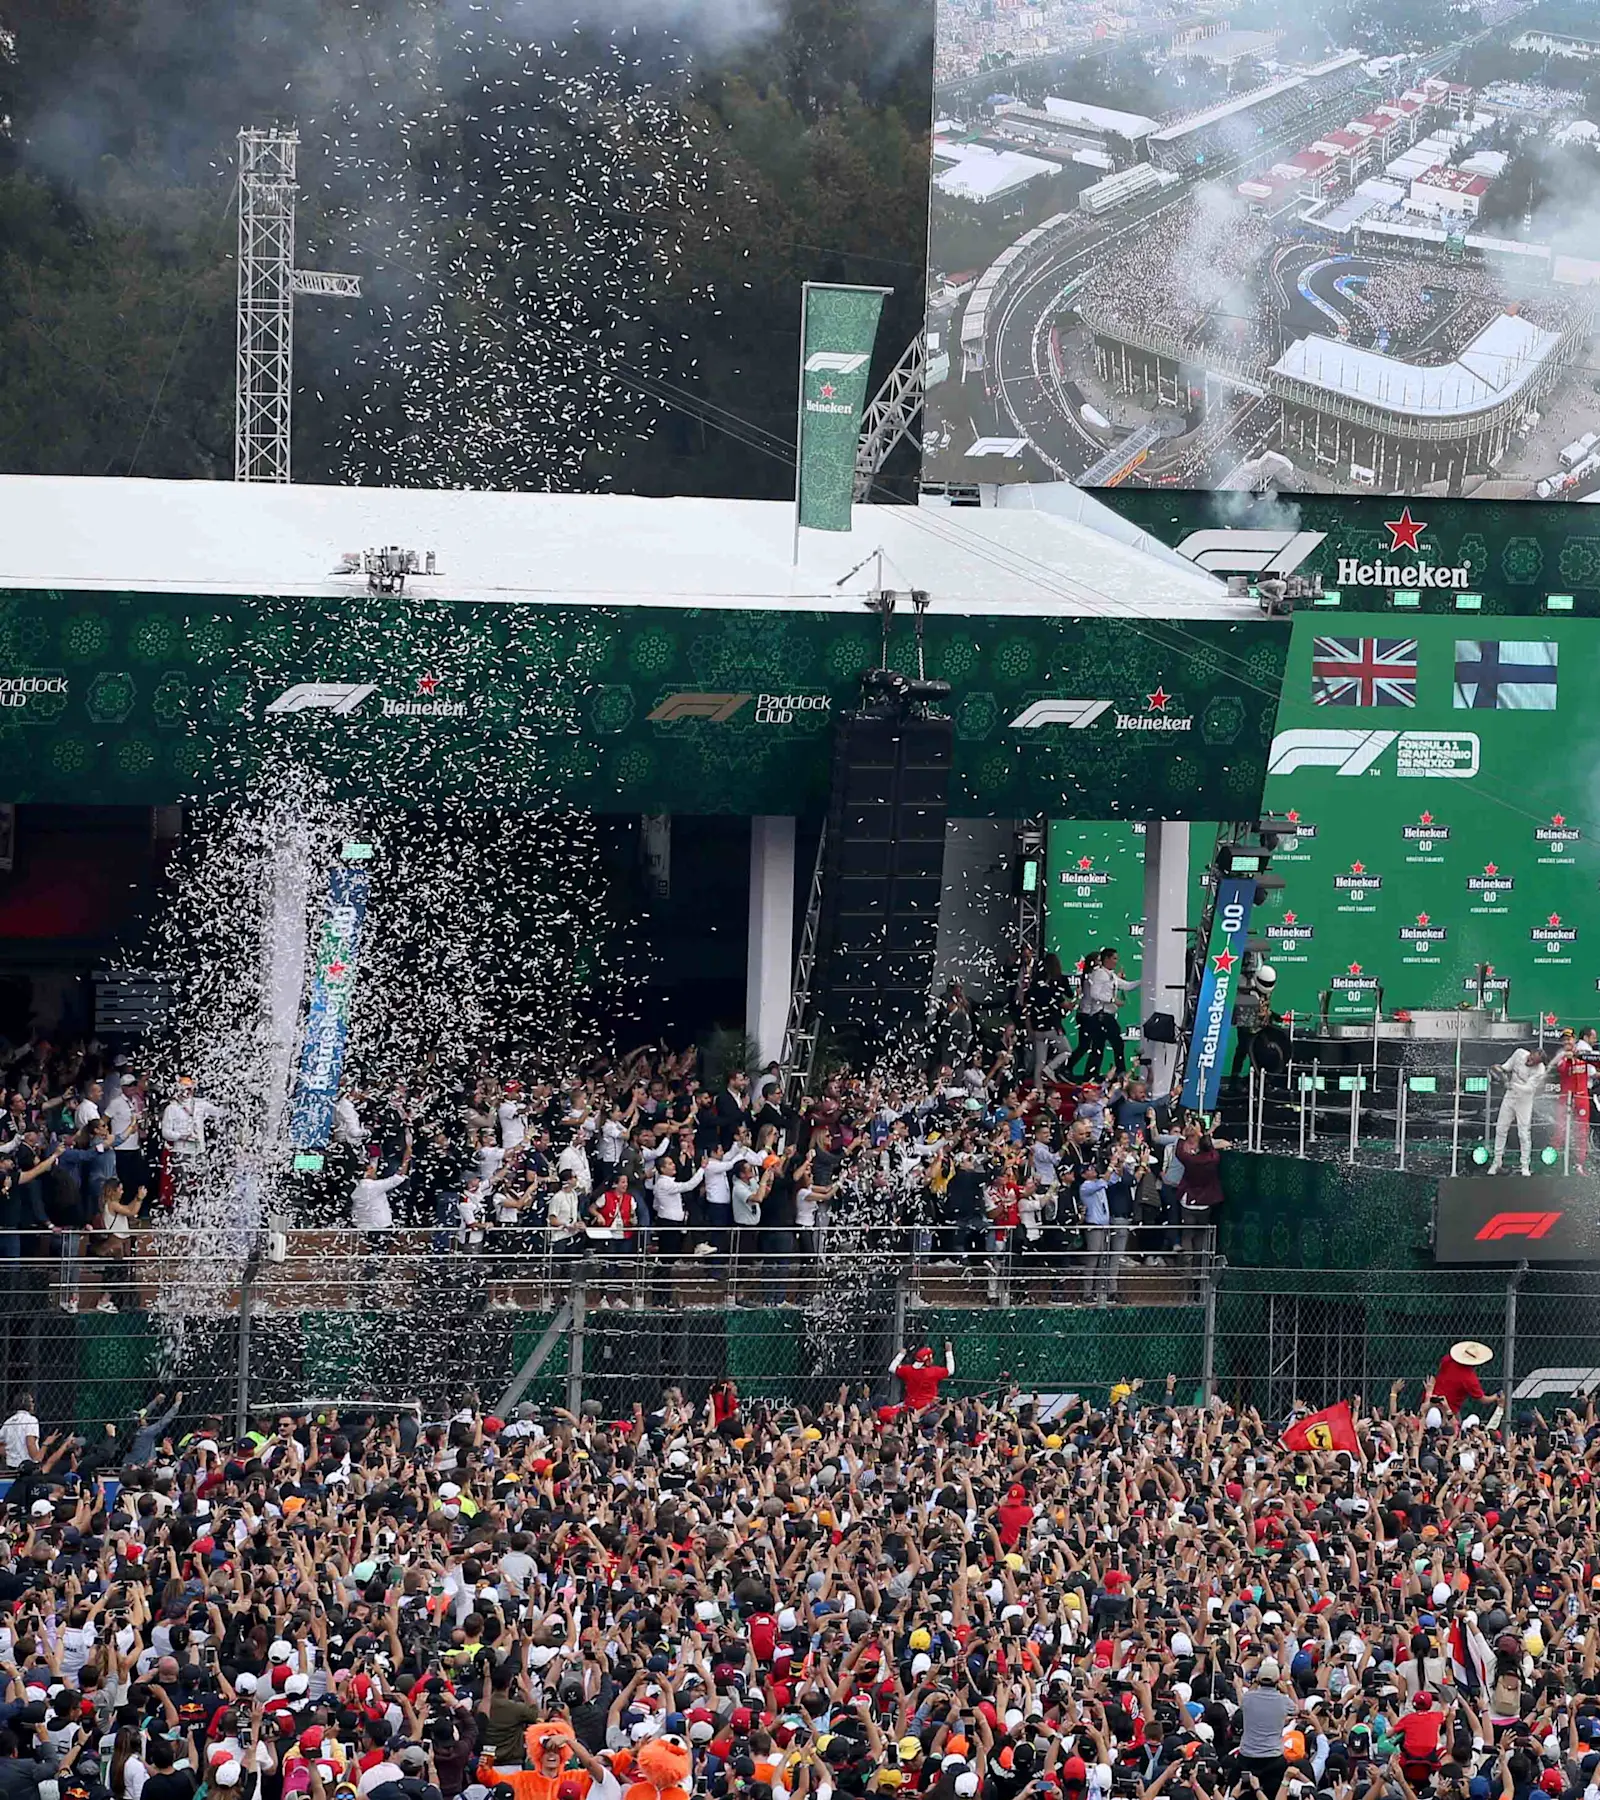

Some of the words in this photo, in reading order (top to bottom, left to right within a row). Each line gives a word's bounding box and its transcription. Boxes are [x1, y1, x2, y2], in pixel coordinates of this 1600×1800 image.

[806, 399, 851, 414] Heineken
[1336, 558, 1469, 588] Heineken
[0, 692, 27, 707] lub
[756, 693, 832, 710] Paddock
[382, 698, 465, 716] Heineken
[755, 708, 793, 724] Club
[1115, 714, 1193, 731] Heineken
[1398, 740, 1451, 750] FORMULA
[1397, 750, 1429, 759] GRAN
[1429, 750, 1472, 759] PREMIO
[1397, 759, 1412, 768] DE
[1404, 828, 1448, 838] Heineken
[1536, 829, 1579, 839] Heineken
[1061, 873, 1107, 883] Heineken
[1336, 877, 1380, 887] Heineken
[1469, 879, 1512, 889] Heineken
[1221, 904, 1244, 933] 0.0
[1268, 927, 1311, 937] Heineken
[1401, 929, 1444, 938] Heineken
[1533, 929, 1575, 939] Heineken
[1333, 978, 1377, 988] Heineken
[1465, 979, 1508, 989] Heeken
[1197, 976, 1230, 1069] Heineken
